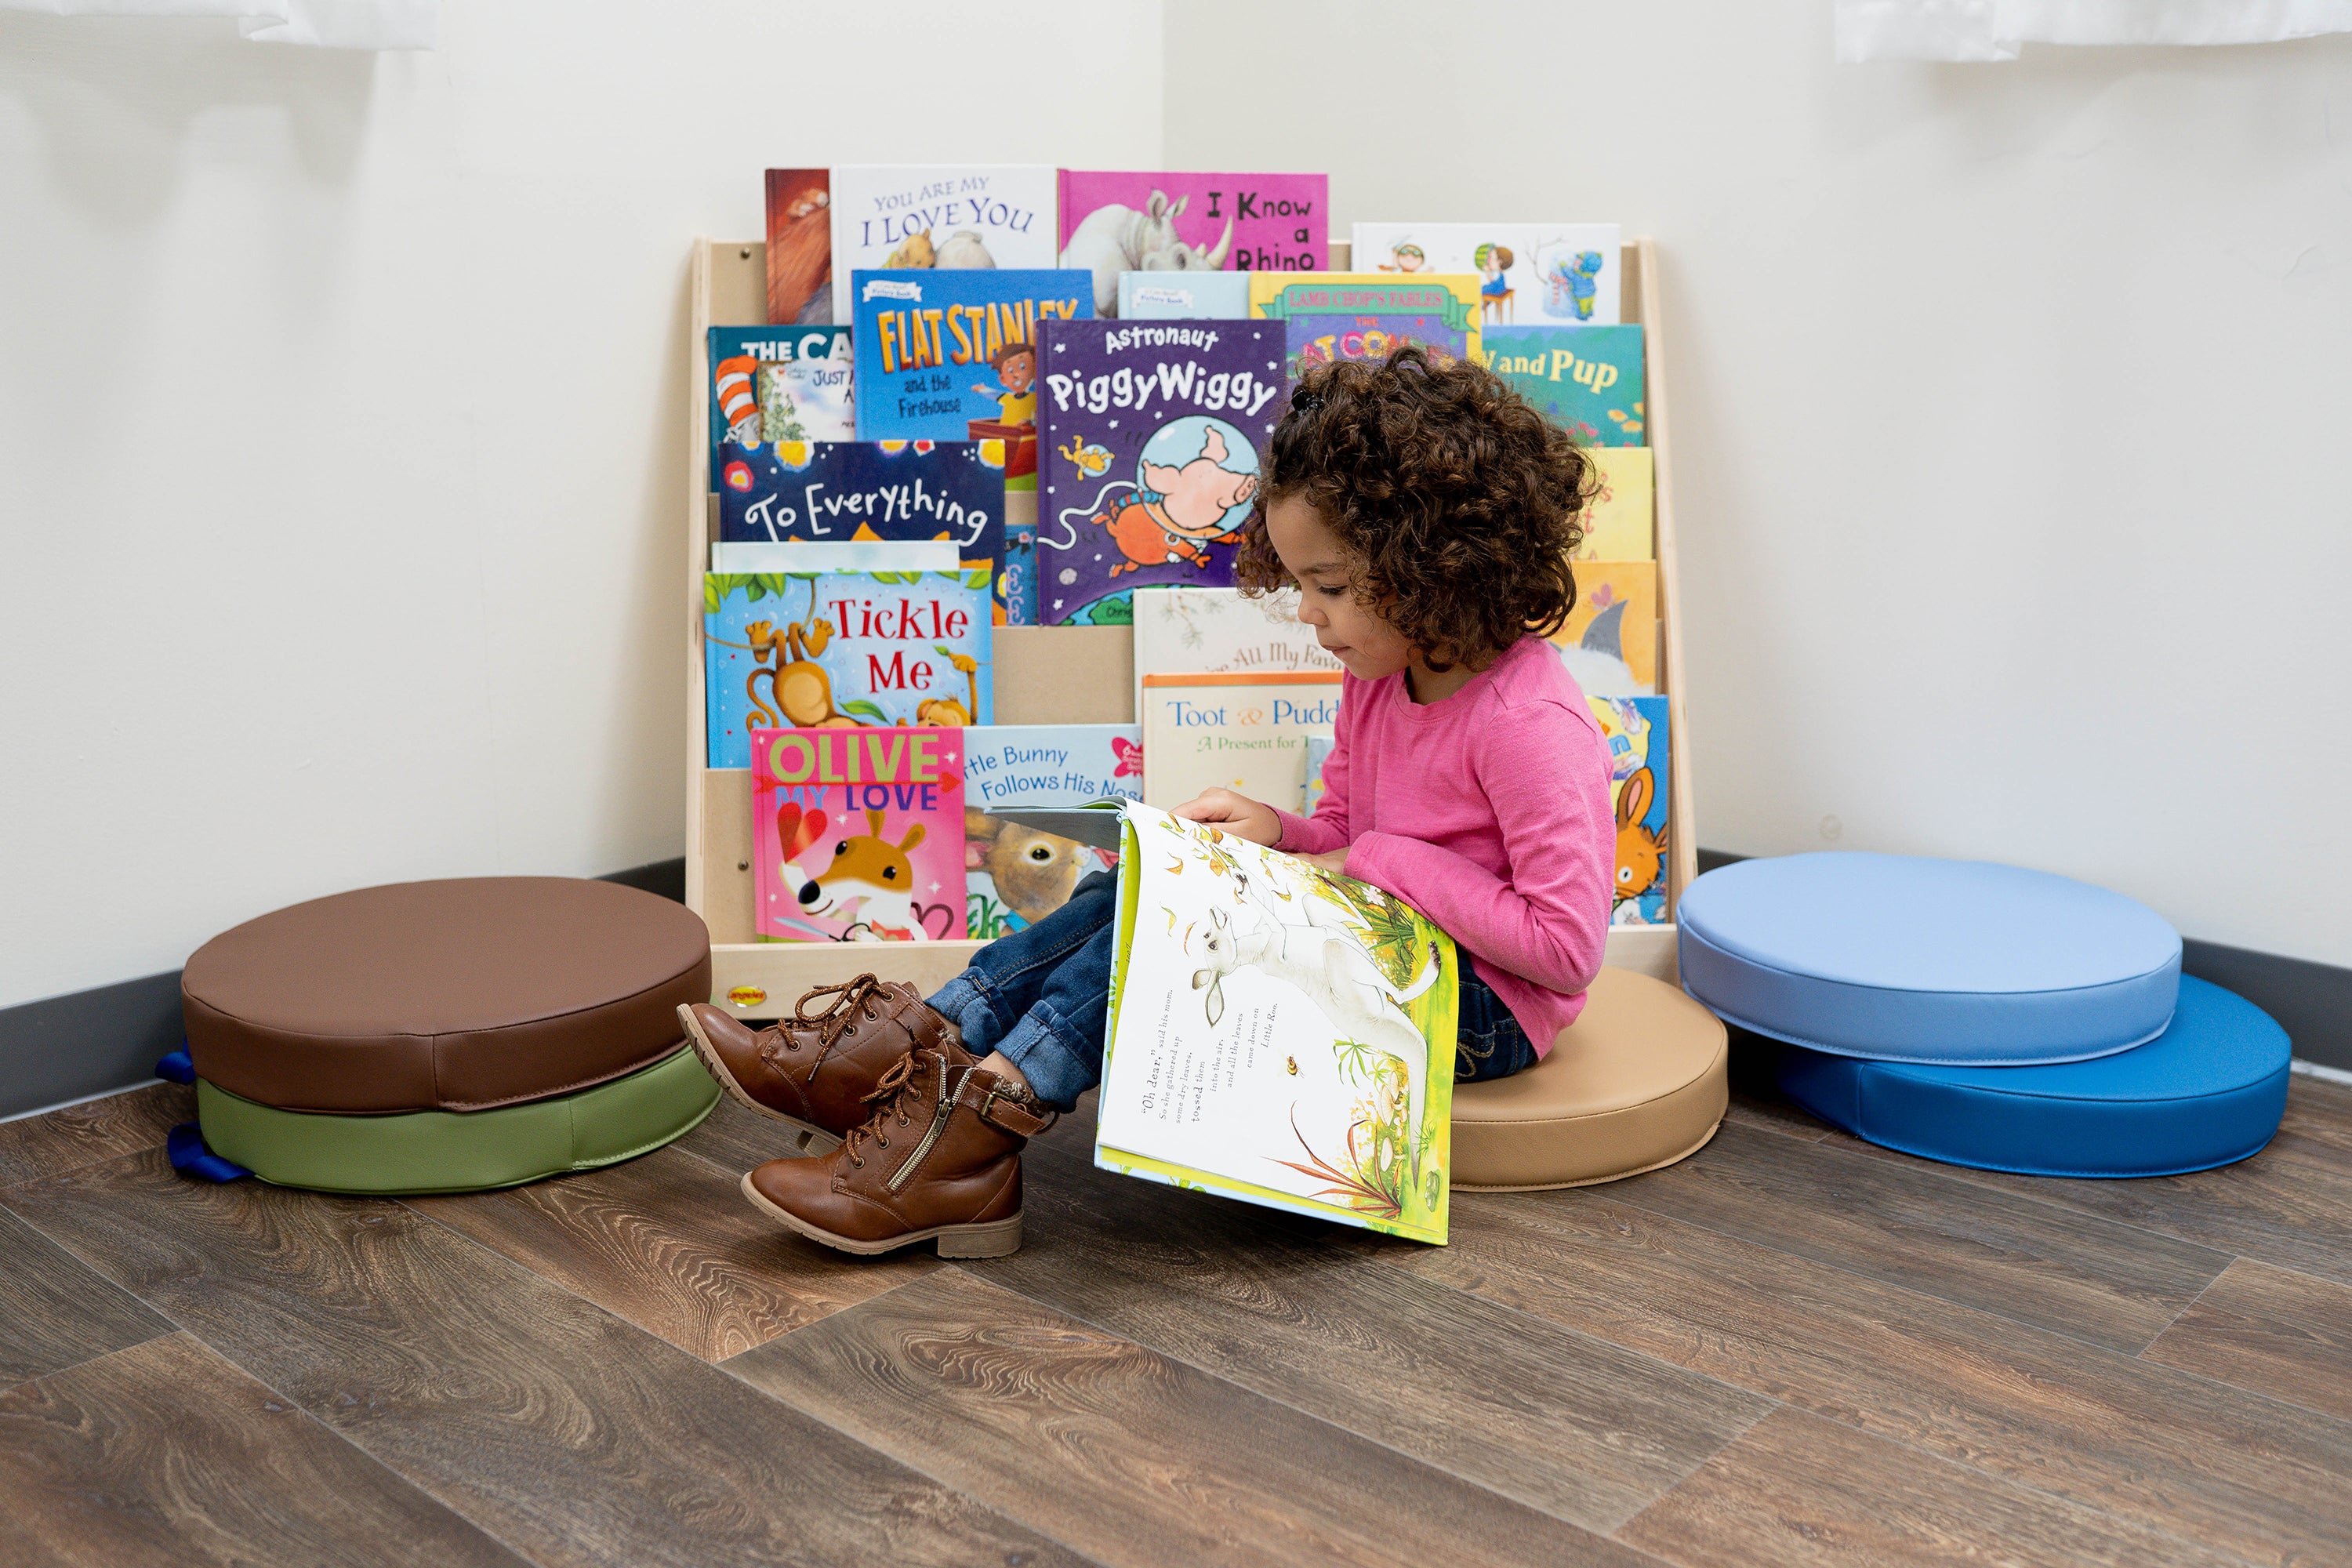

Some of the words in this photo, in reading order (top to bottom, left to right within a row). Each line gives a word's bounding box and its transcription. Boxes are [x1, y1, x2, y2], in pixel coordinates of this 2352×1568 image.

[874, 191, 912, 212] YOU
[920, 180, 955, 201] ARE
[960, 176, 989, 192] MY
[1207, 192, 1222, 217] I
[1237, 192, 1312, 220] Know
[862, 220, 871, 247] I
[882, 203, 963, 244] LOVE
[967, 197, 1034, 233] YOU
[1294, 229, 1308, 243] a
[1237, 243, 1314, 270] Rhino
[1289, 291, 1330, 307] LAMB
[1333, 291, 1386, 307] CHOP'S
[1390, 291, 1443, 307] FABLES
[1356, 317, 1377, 327] THE
[741, 341, 793, 361] THE
[877, 307, 943, 373] FLAT
[1105, 326, 1219, 354] Astronaut
[813, 370, 847, 387] JUST
[904, 376, 927, 394] and
[931, 376, 951, 390] the
[1498, 354, 1546, 376] and
[1548, 349, 1618, 395] Pup
[1046, 360, 1277, 416] PiggyWiggy
[898, 397, 961, 418] Firehouse
[745, 493, 797, 542] To
[805, 478, 988, 546] Everything
[829, 598, 968, 640] Tickle
[1233, 648, 1265, 666] All
[1269, 642, 1299, 670] My
[866, 651, 933, 694] Me
[1166, 702, 1228, 727] Toot
[1237, 708, 1263, 726] &
[1004, 746, 1068, 767] Bunny
[1196, 736, 1212, 753] A
[1218, 737, 1272, 750] Present
[1276, 736, 1298, 749] for
[769, 734, 939, 782] OLIVE
[775, 786, 829, 811] MY
[846, 784, 938, 811] LOVE
[981, 775, 1059, 800] Follows
[1064, 772, 1094, 795] His
[1159, 1014, 1168, 1028] his
[1164, 989, 1173, 1011] mom.
[1266, 1003, 1279, 1021] Roo.
[1232, 1013, 1243, 1040] leaves
[1248, 1022, 1258, 1045] down
[1254, 1007, 1259, 1019] on
[1261, 1022, 1273, 1048] Little
[1174, 1036, 1183, 1047] up
[1230, 1040, 1239, 1055] the
[1166, 1049, 1178, 1090] gathered
[1195, 1061, 1206, 1083] them
[1212, 1057, 1221, 1072] the
[1228, 1057, 1236, 1069] all
[1178, 1084, 1189, 1101] dry
[1210, 1074, 1218, 1092] into
[1161, 1091, 1170, 1107] she
[1191, 1087, 1203, 1123] tossed
[1159, 1109, 1167, 1120] So
